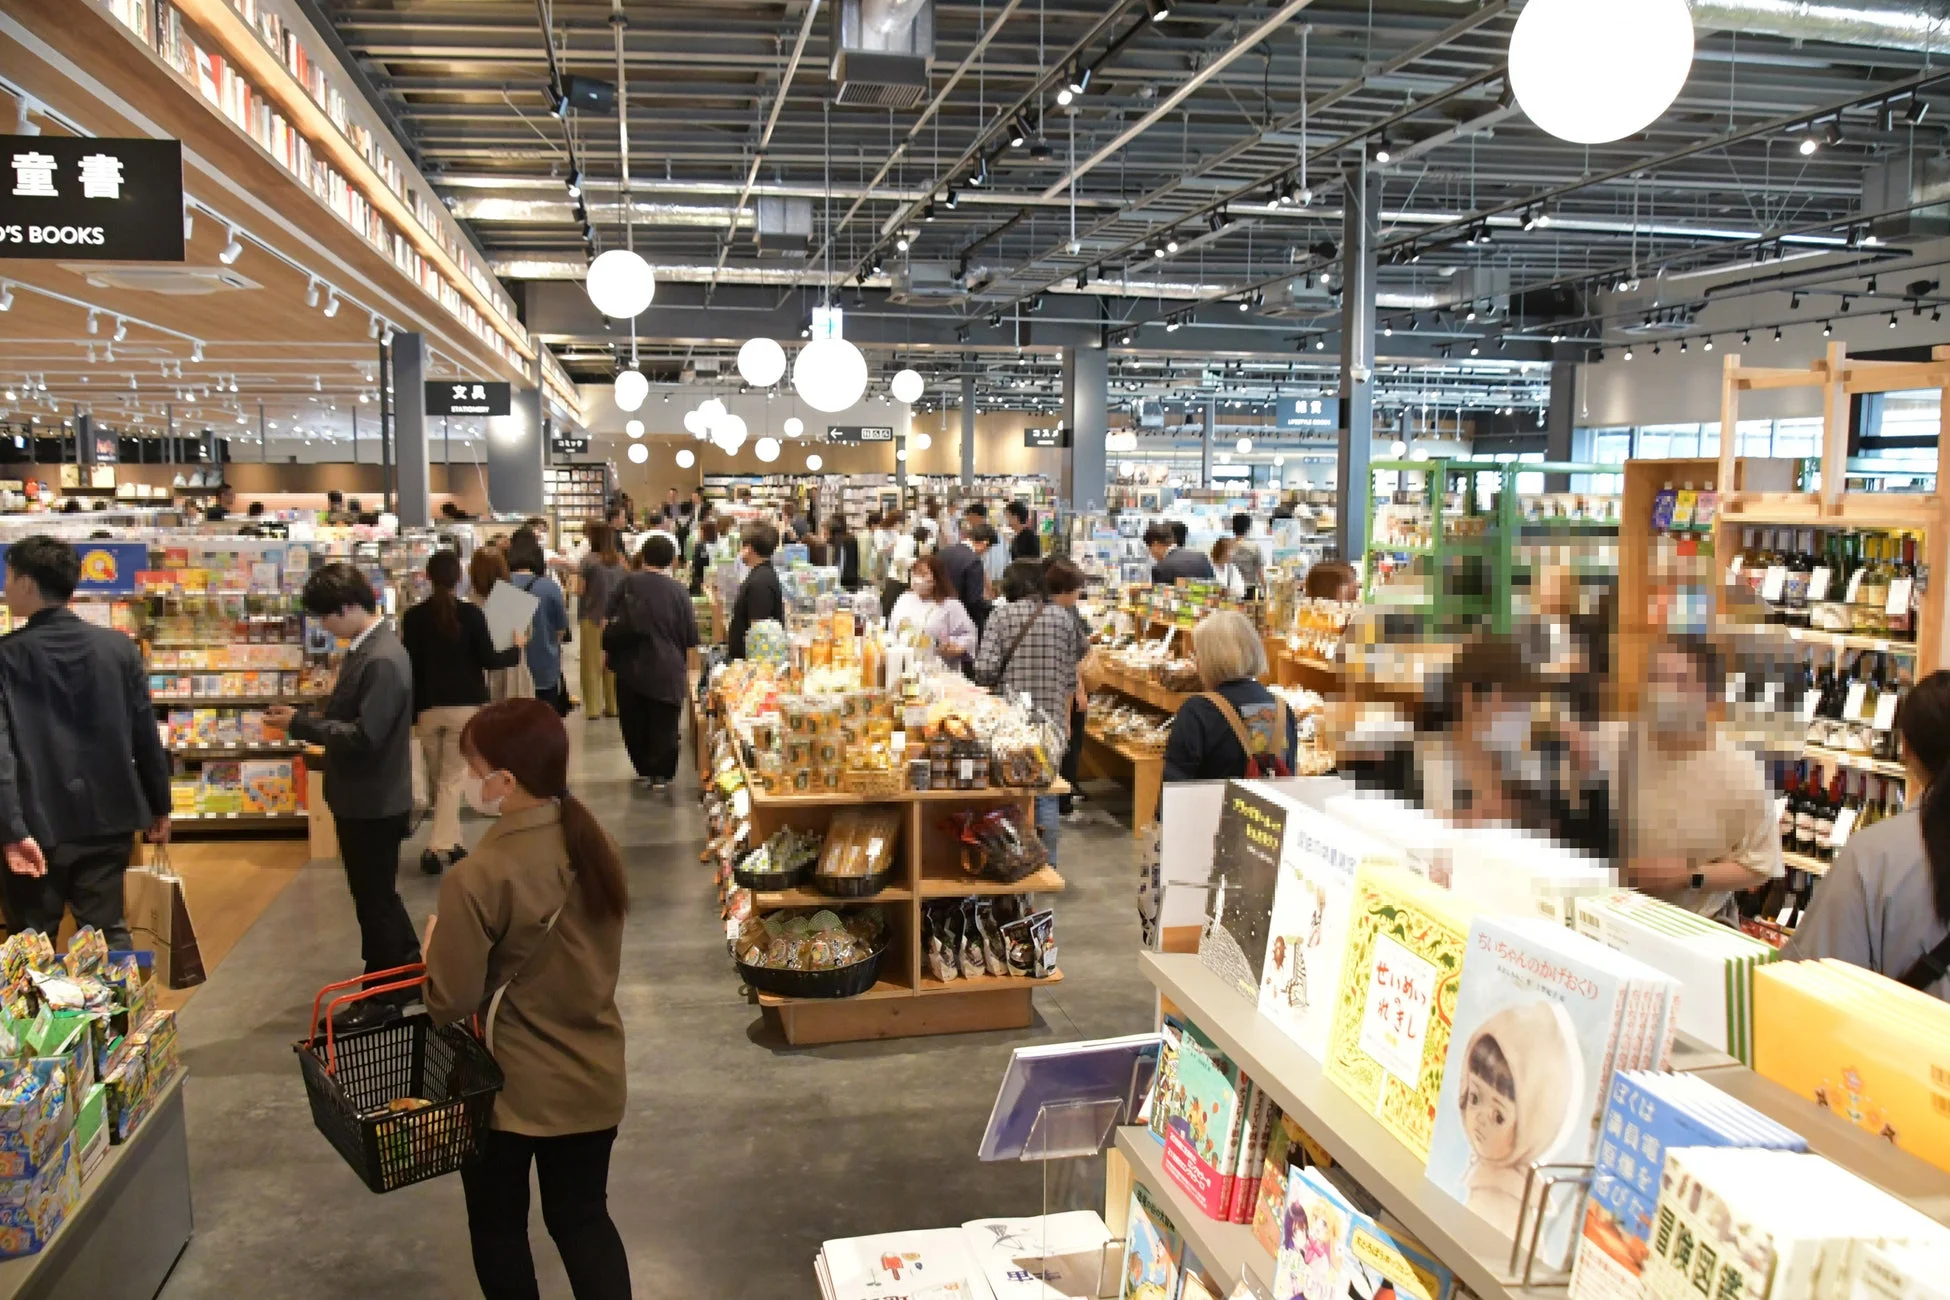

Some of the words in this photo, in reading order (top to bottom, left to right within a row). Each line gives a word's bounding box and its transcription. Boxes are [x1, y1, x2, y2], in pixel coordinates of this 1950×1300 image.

[28, 226, 105, 245] BOOKS
[451, 405, 490, 413] STATIONERY
[452, 384, 486, 400] 文具
[1376, 959, 1427, 1007] せいめい
[1476, 932, 1600, 1001] ちいちゃんのかげおくり
[1377, 998, 1417, 1040] れきし
[1613, 1081, 1657, 1123] ぼくは
